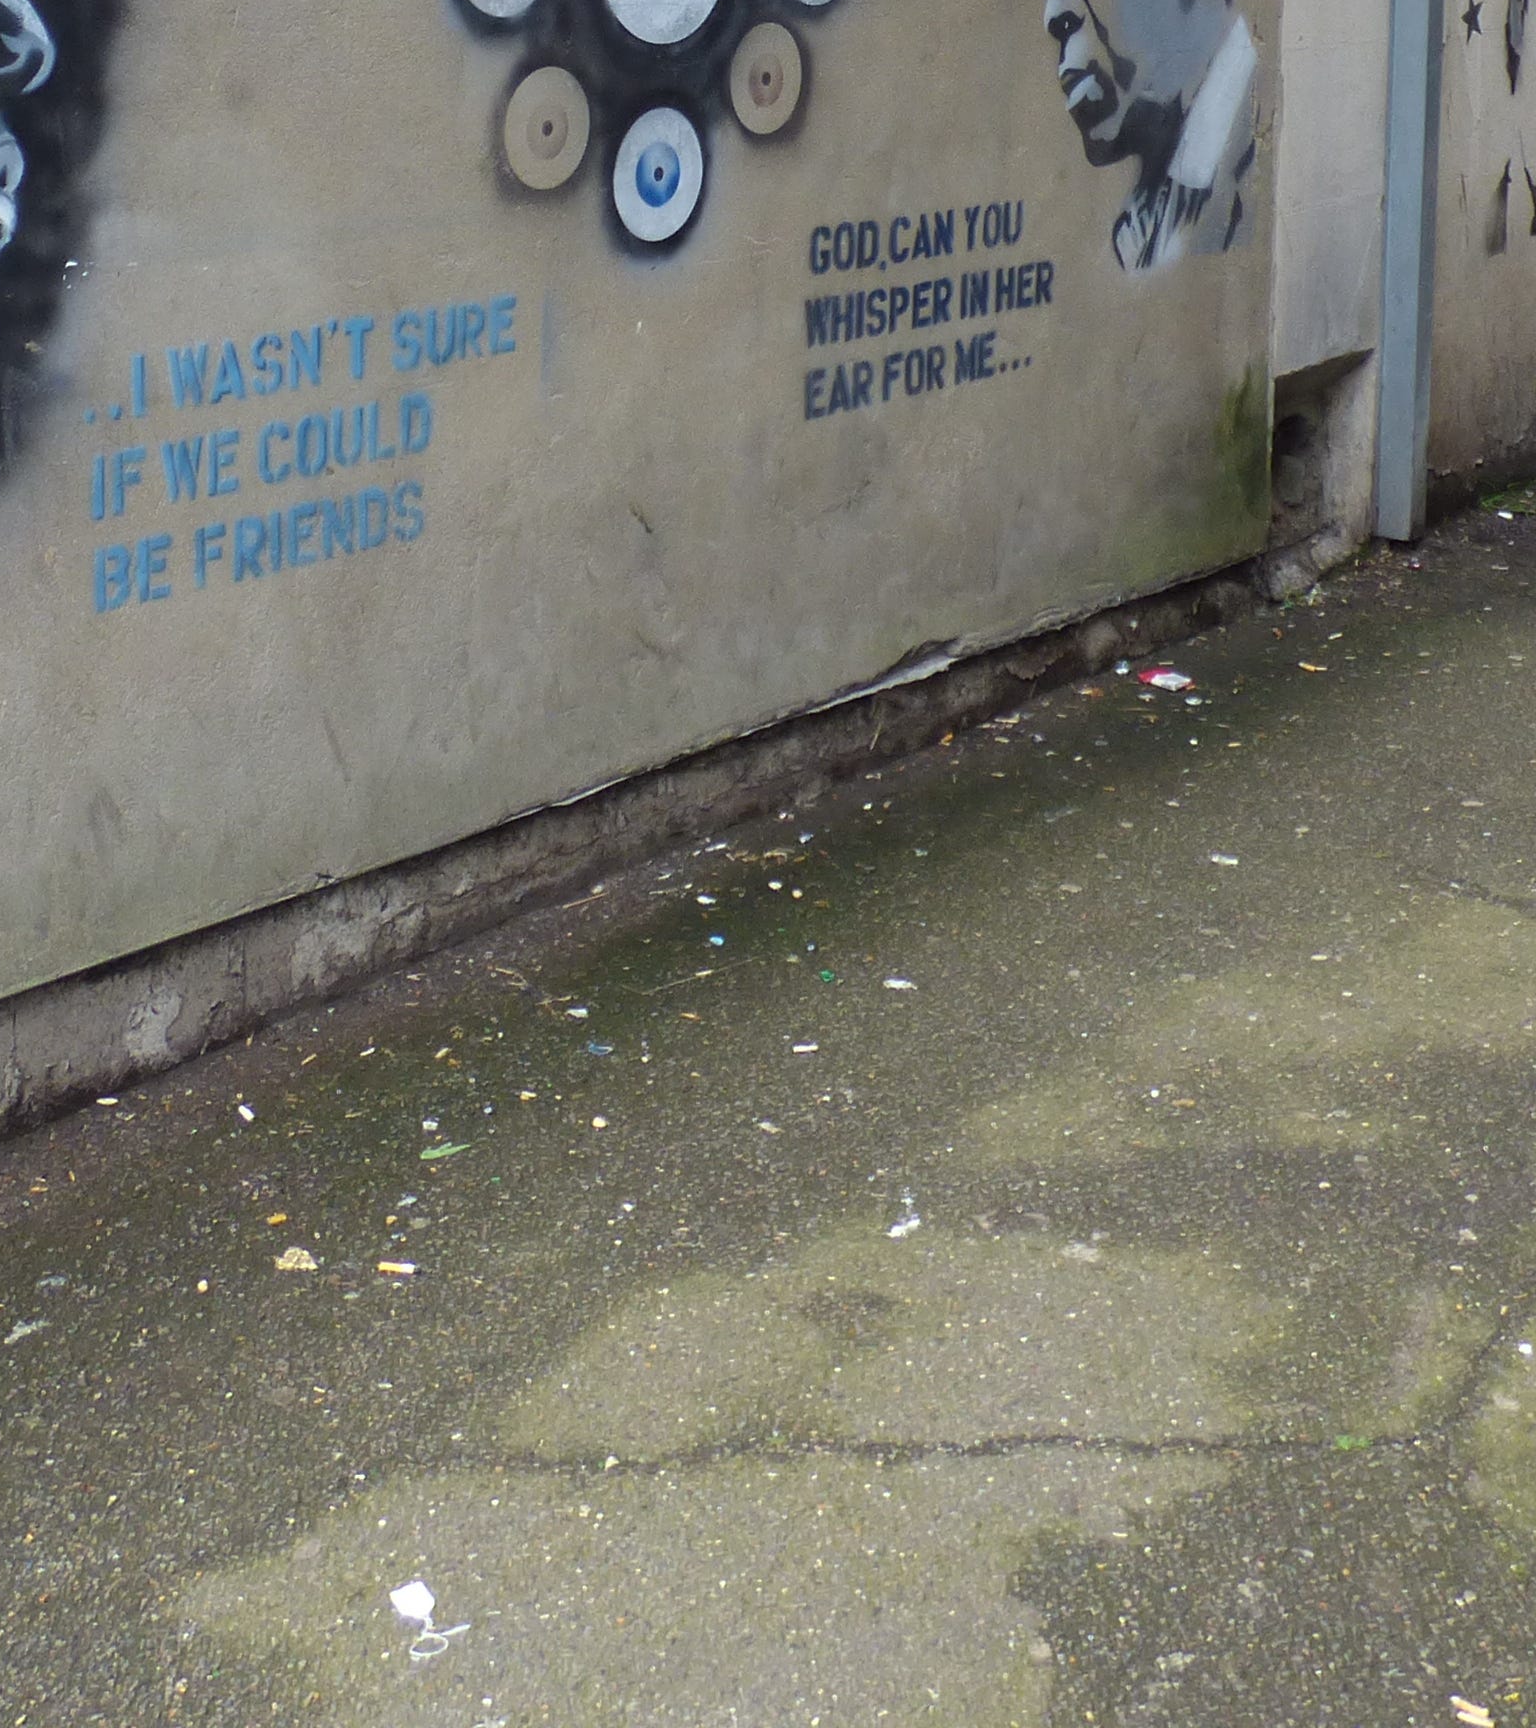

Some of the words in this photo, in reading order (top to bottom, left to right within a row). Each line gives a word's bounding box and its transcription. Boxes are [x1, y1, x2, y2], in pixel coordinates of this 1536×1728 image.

[964, 199, 1024, 253] YOU
[166, 315, 374, 410] WASN'T
[391, 293, 517, 373] SURE
[805, 277, 954, 349] WHISPER
[960, 269, 990, 320] IN
[995, 259, 1056, 314] HER
[805, 360, 875, 421] EAR
[882, 344, 946, 402] FOR
[954, 330, 1033, 386] ME...
[90, 445, 148, 521] IF
[160, 429, 241, 504] WE
[257, 391, 433, 485] COULD
[94, 534, 173, 614] BE
[194, 481, 426, 589] FRIENDS
